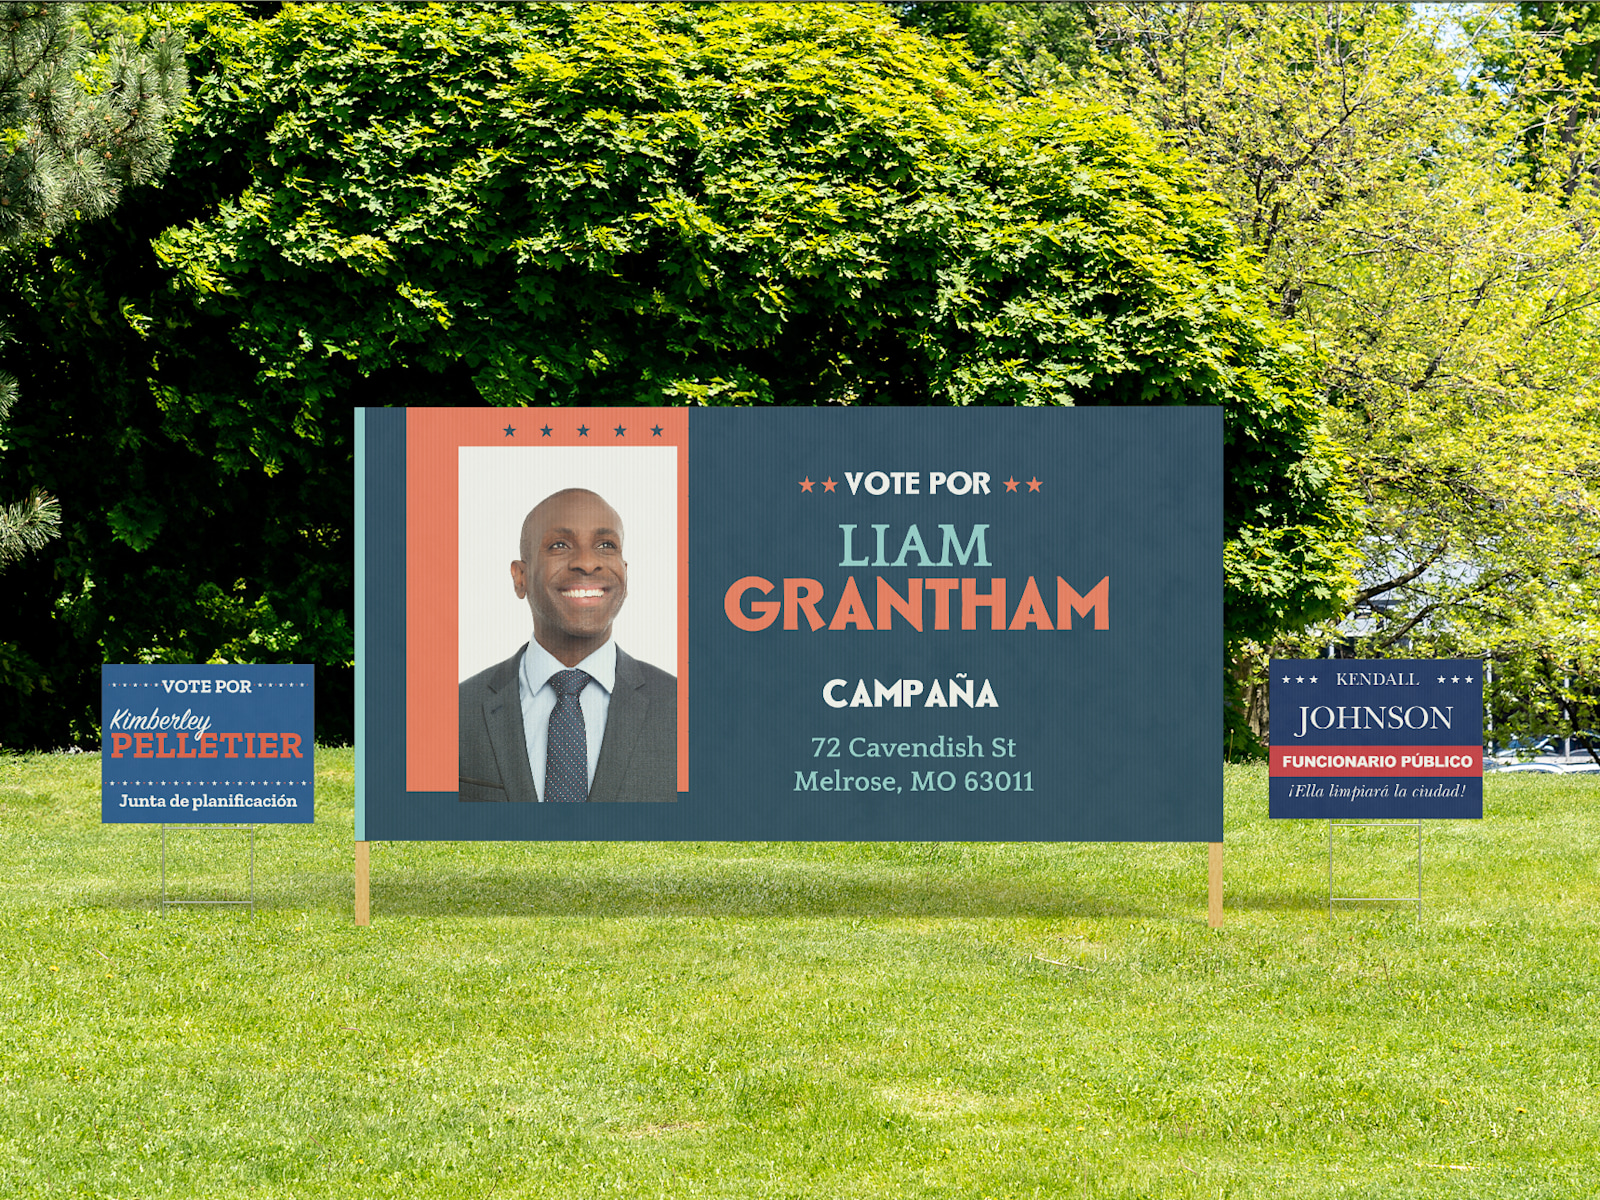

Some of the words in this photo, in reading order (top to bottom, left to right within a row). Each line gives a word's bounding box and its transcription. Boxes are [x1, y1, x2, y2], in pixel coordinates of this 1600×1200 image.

[844, 471, 920, 495] VOTE
[929, 471, 992, 495] POR
[838, 523, 992, 567] LIAM
[723, 575, 1110, 632] GRANTHAM
[162, 680, 211, 693] VOTE
[215, 680, 252, 693] POR
[822, 672, 999, 709] CAMPAÑA
[1337, 673, 1420, 686] KENDALL
[110, 707, 212, 741] Kimberley
[1294, 706, 1454, 738] JOHNSON
[111, 733, 303, 758] PELLETIER
[811, 737, 841, 758] 72
[848, 735, 985, 758] Cavendish
[992, 737, 1017, 758] St
[1283, 755, 1396, 768] FUNCIONARIO
[1401, 753, 1473, 768] PÚBLICO
[793, 769, 902, 794] Melrose,
[910, 771, 957, 792] MO
[964, 771, 1034, 792] 63011
[1289, 784, 1324, 798] ¡Ella
[1329, 784, 1389, 801] limpiará
[1394, 784, 1407, 798] la
[1412, 784, 1466, 798] ciudad!
[119, 795, 166, 808] Junta
[171, 794, 189, 808] de
[192, 794, 297, 811] planificación
